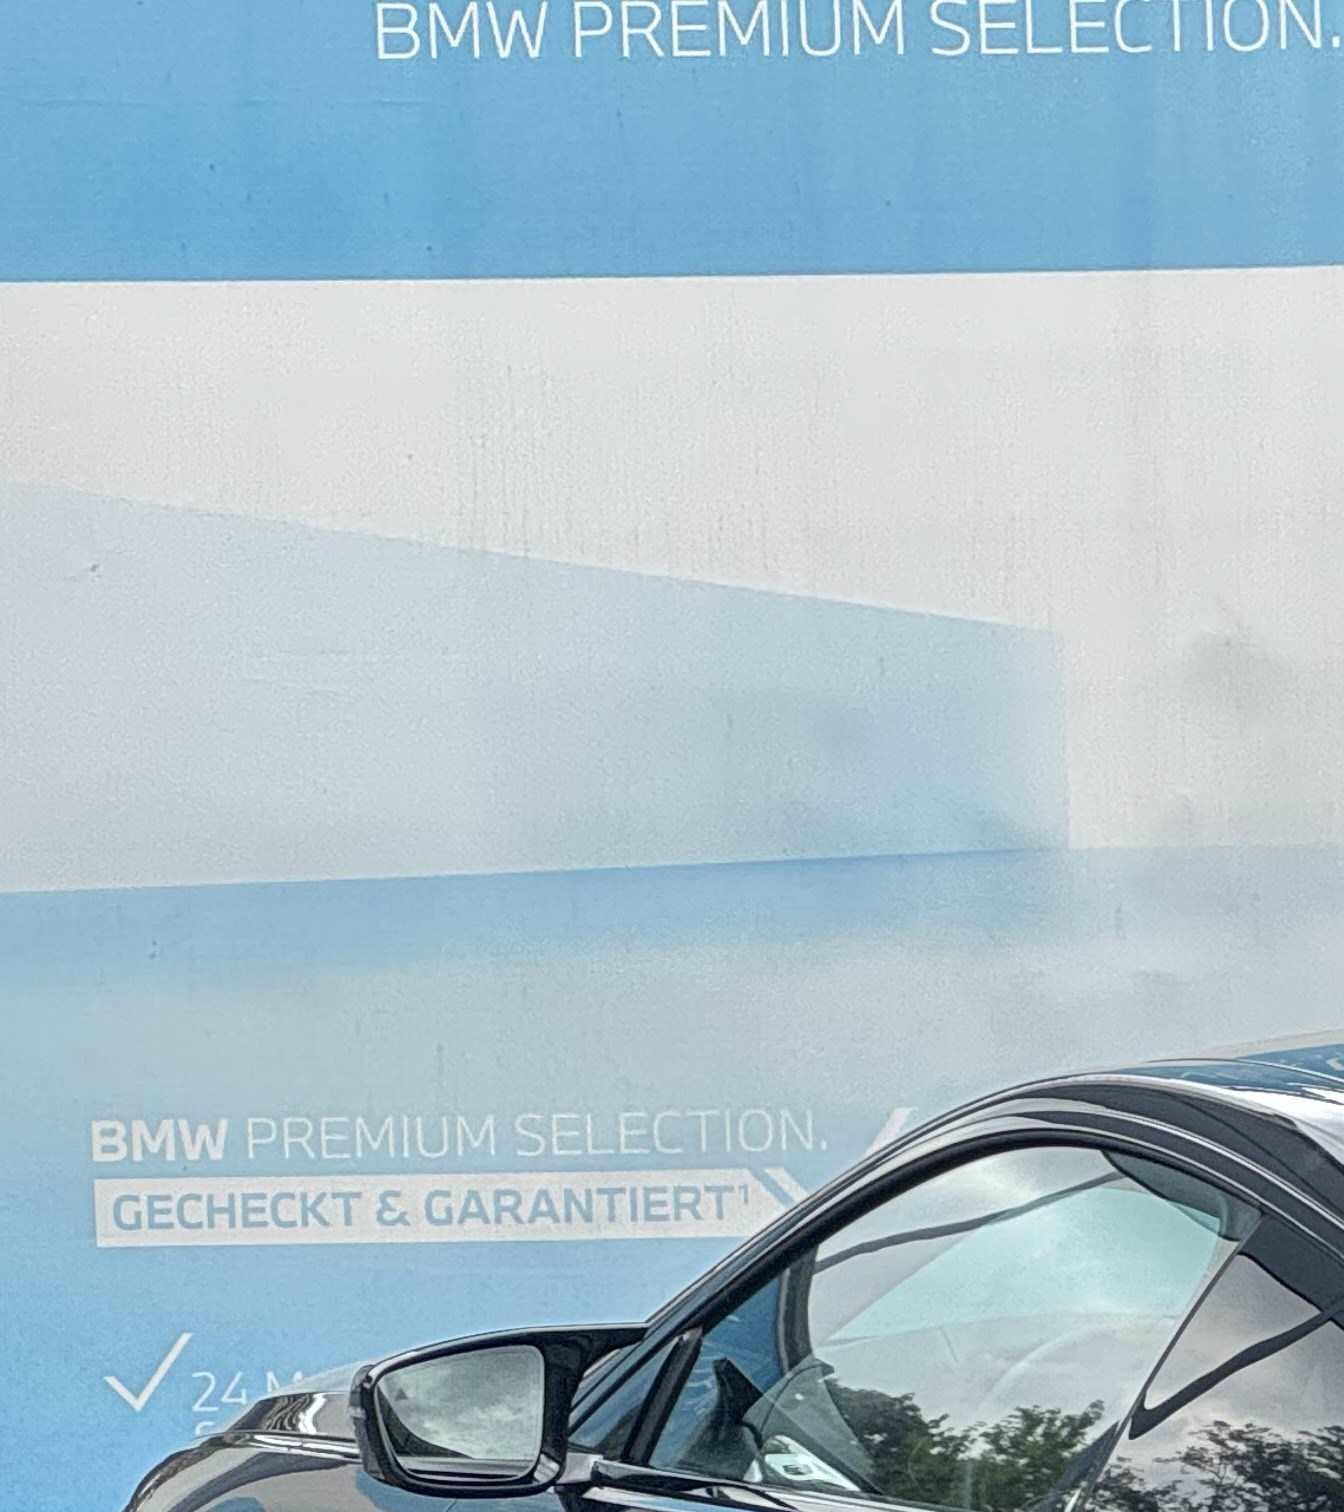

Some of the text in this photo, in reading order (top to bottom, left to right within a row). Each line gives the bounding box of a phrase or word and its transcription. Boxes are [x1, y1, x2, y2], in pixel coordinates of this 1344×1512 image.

[375, 0, 1343, 60] BMW PREMIUM SELECTION.
[91, 1108, 828, 1162] BMW PREMIUM SELECTION.
[111, 1190, 363, 1231] GECHECKT
[375, 1188, 412, 1228] &
[191, 1370, 248, 1412] 24
